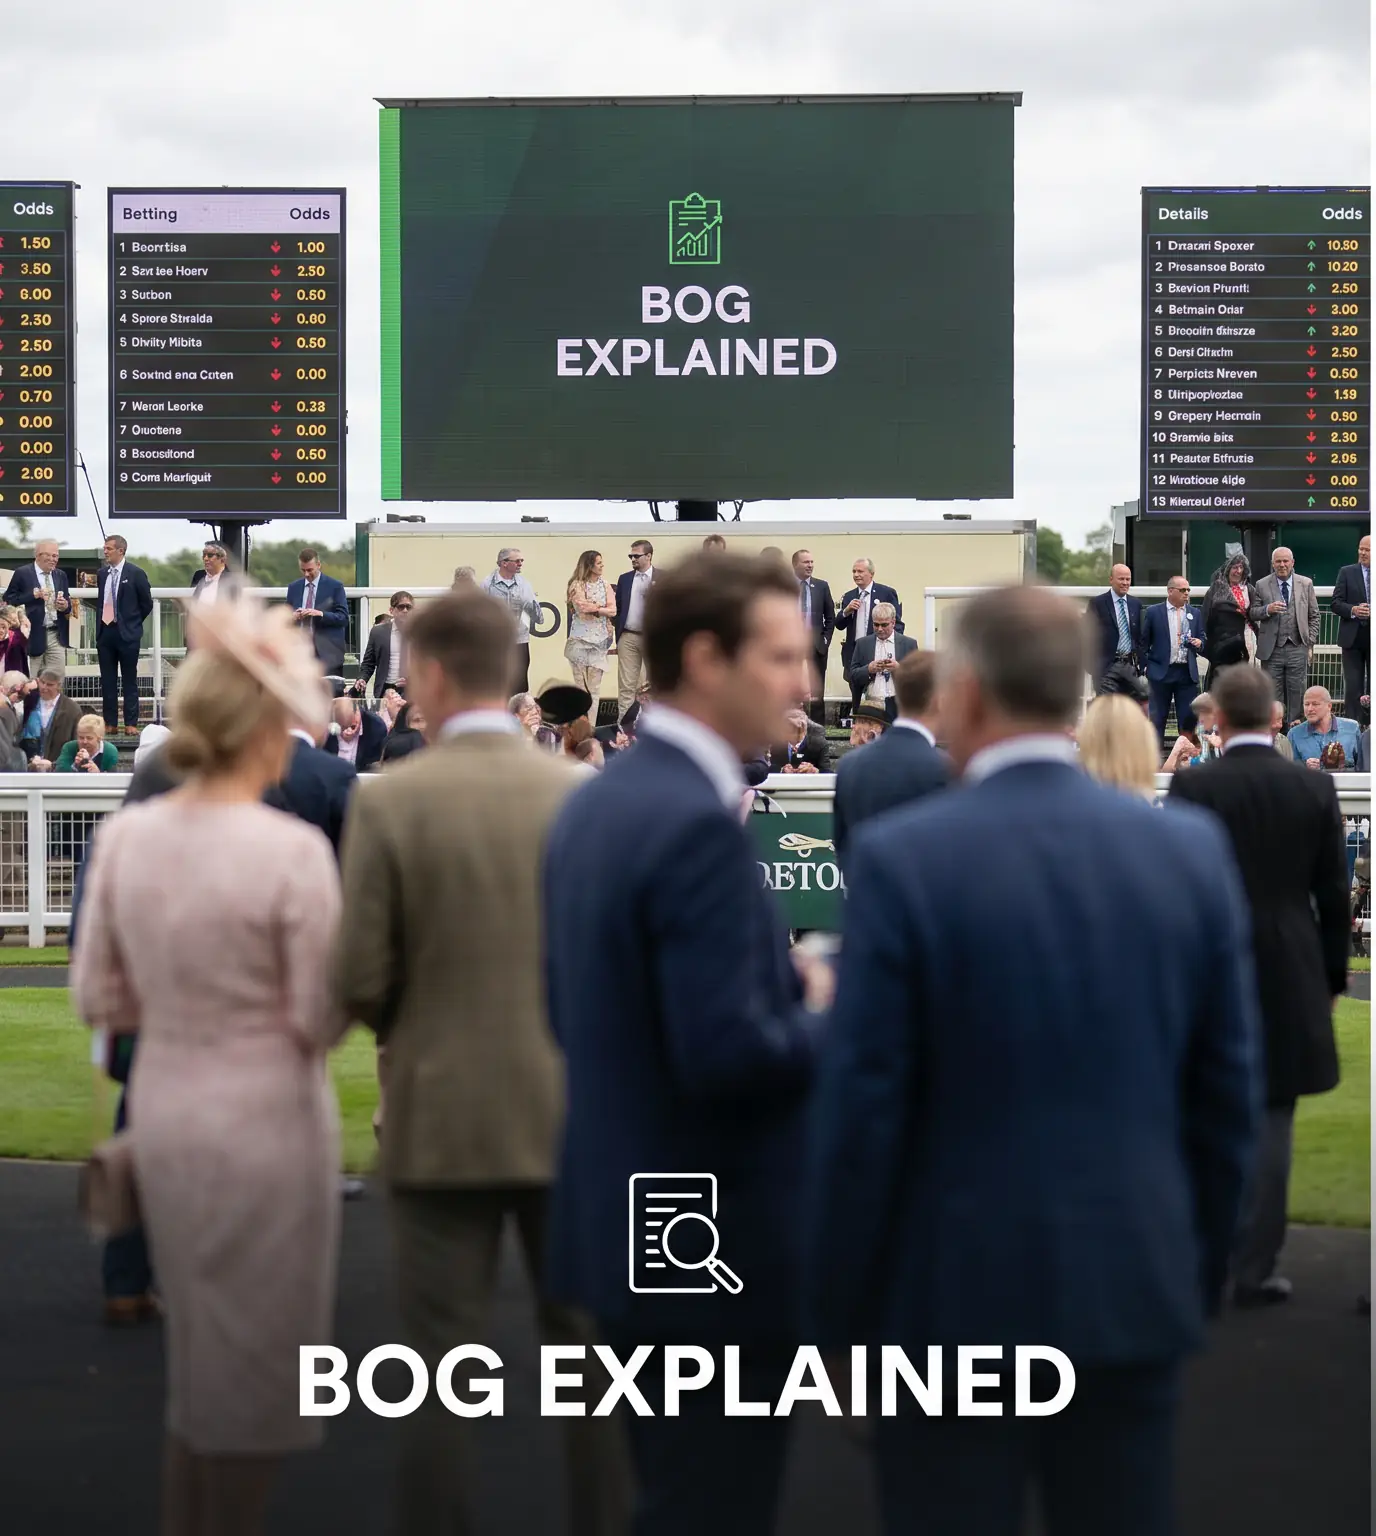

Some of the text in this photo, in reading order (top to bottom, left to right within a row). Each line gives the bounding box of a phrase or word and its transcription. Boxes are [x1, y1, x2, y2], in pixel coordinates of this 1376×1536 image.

[14, 202, 53, 215] Odds
[1159, 208, 1362, 219] Details Odds
[124, 208, 330, 222] Betting Odds
[21, 237, 50, 249] 1.50
[120, 242, 124, 252] 1
[298, 242, 324, 252] 1.00
[1156, 241, 1160, 250] 1
[21, 263, 51, 274] 3.50
[120, 266, 126, 276] 2
[298, 266, 325, 276] 2.50
[1156, 262, 1162, 271] 2
[1156, 283, 1162, 292] 3
[1332, 283, 1358, 293] 2.50
[120, 290, 126, 299] 3
[642, 285, 750, 323] BOG
[1155, 305, 1163, 314] 4
[1332, 304, 1358, 314] 3.00
[21, 314, 51, 325] 2.30
[120, 314, 127, 323] 4
[1155, 326, 1162, 335] 5
[1332, 326, 1357, 336] 3.20
[21, 340, 52, 351] 2.50
[1155, 347, 1162, 356] 6
[1332, 347, 1357, 357] 2.50
[557, 339, 837, 376] EXPLAINED
[20, 365, 52, 377] 2.00
[120, 370, 127, 379] 6
[297, 369, 326, 379] 0.00
[1154, 369, 1162, 378] 7
[20, 390, 52, 402] 0.70
[1154, 389, 1162, 399] 8
[120, 402, 126, 411] 7
[1154, 411, 1162, 420] 9
[20, 416, 52, 428] 0.00
[121, 425, 126, 434] 7
[297, 425, 326, 435] 0.00
[1153, 432, 1166, 442] 10
[1331, 432, 1357, 442] 2.30
[21, 442, 52, 453] 0.00
[120, 449, 126, 458] 8
[297, 449, 326, 460] 0.50
[1153, 454, 1164, 463] 11
[120, 473, 128, 482] 9
[297, 472, 326, 483] 0.00
[1153, 475, 1165, 484] 12
[1331, 475, 1357, 485] 0.00
[20, 493, 52, 504] 0.00
